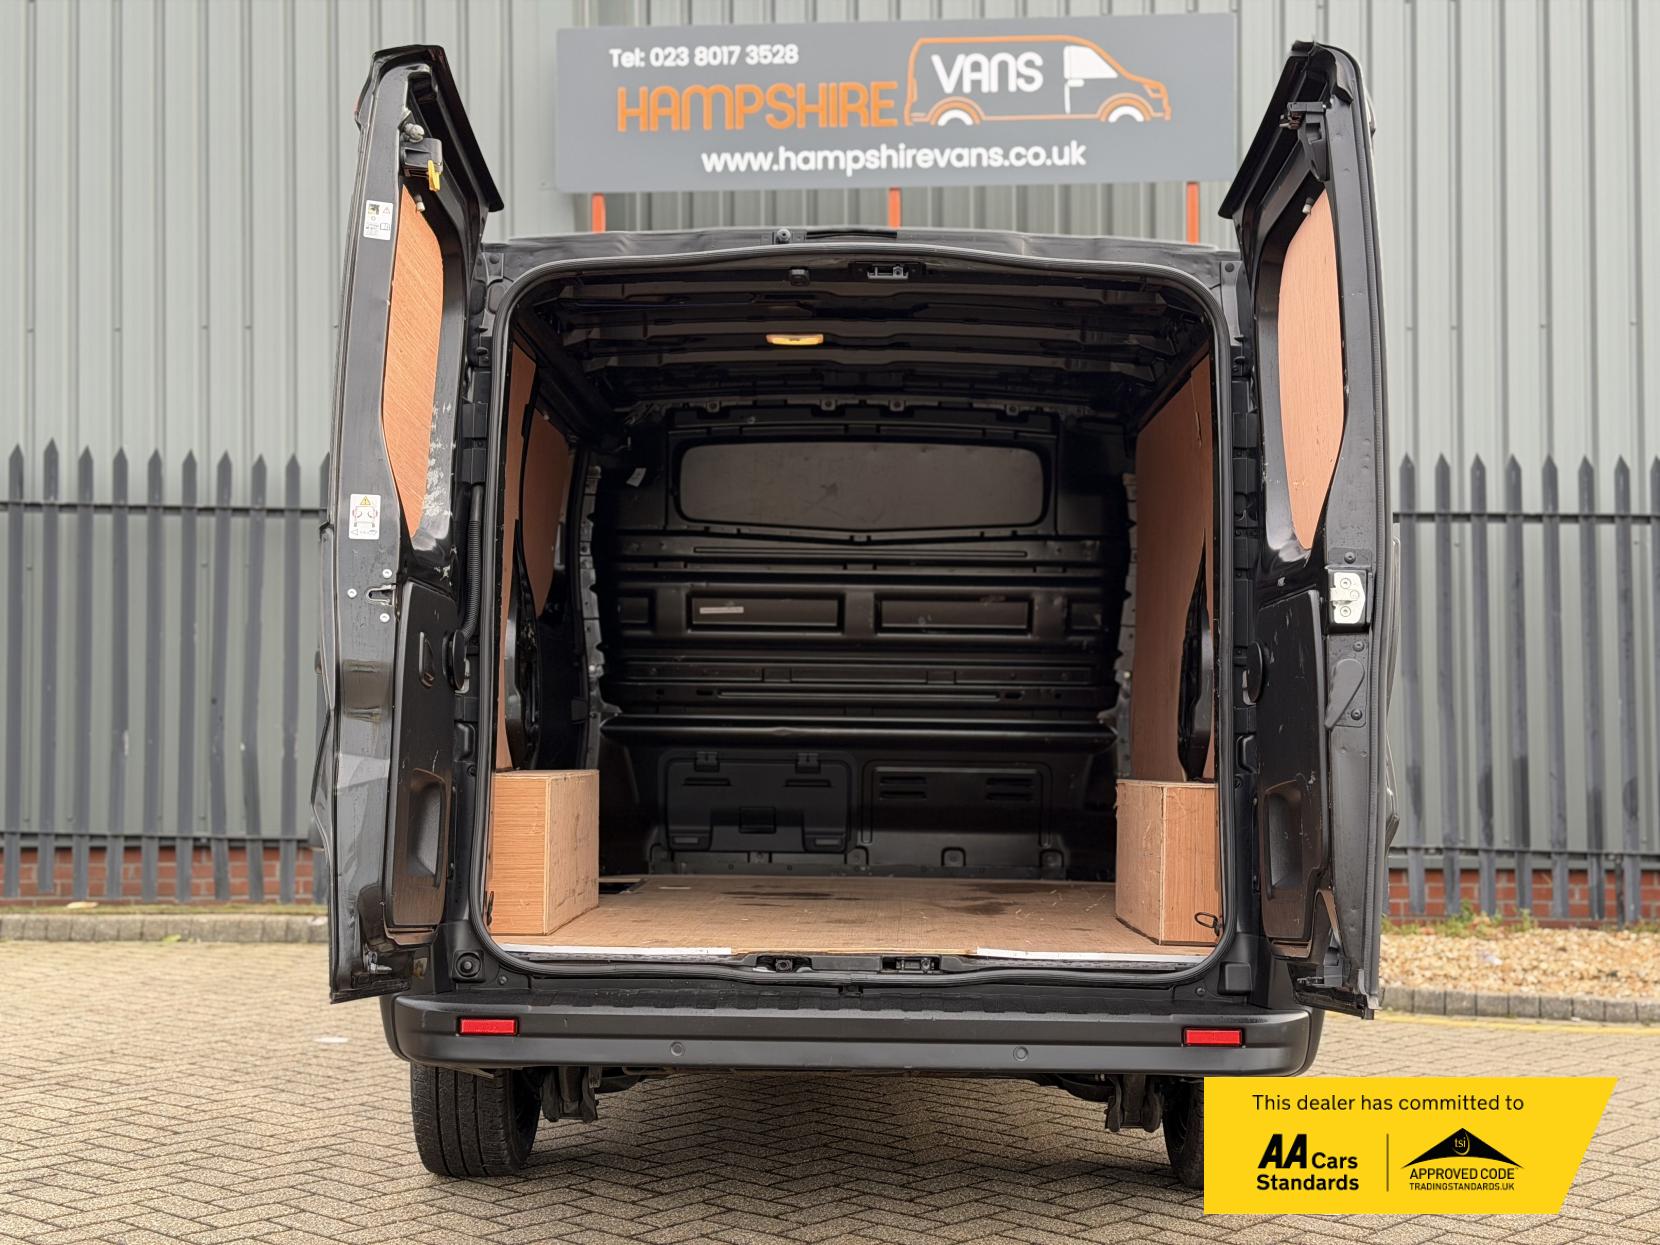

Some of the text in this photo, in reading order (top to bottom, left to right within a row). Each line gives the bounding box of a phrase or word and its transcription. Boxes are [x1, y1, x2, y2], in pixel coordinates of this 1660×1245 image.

[609, 43, 799, 68] Tel: 023 8017 3528
[930, 51, 1044, 94] VANS
[618, 81, 898, 132] HAMPSHIRE
[701, 140, 1087, 177] www.hampshirevans.co.uk
